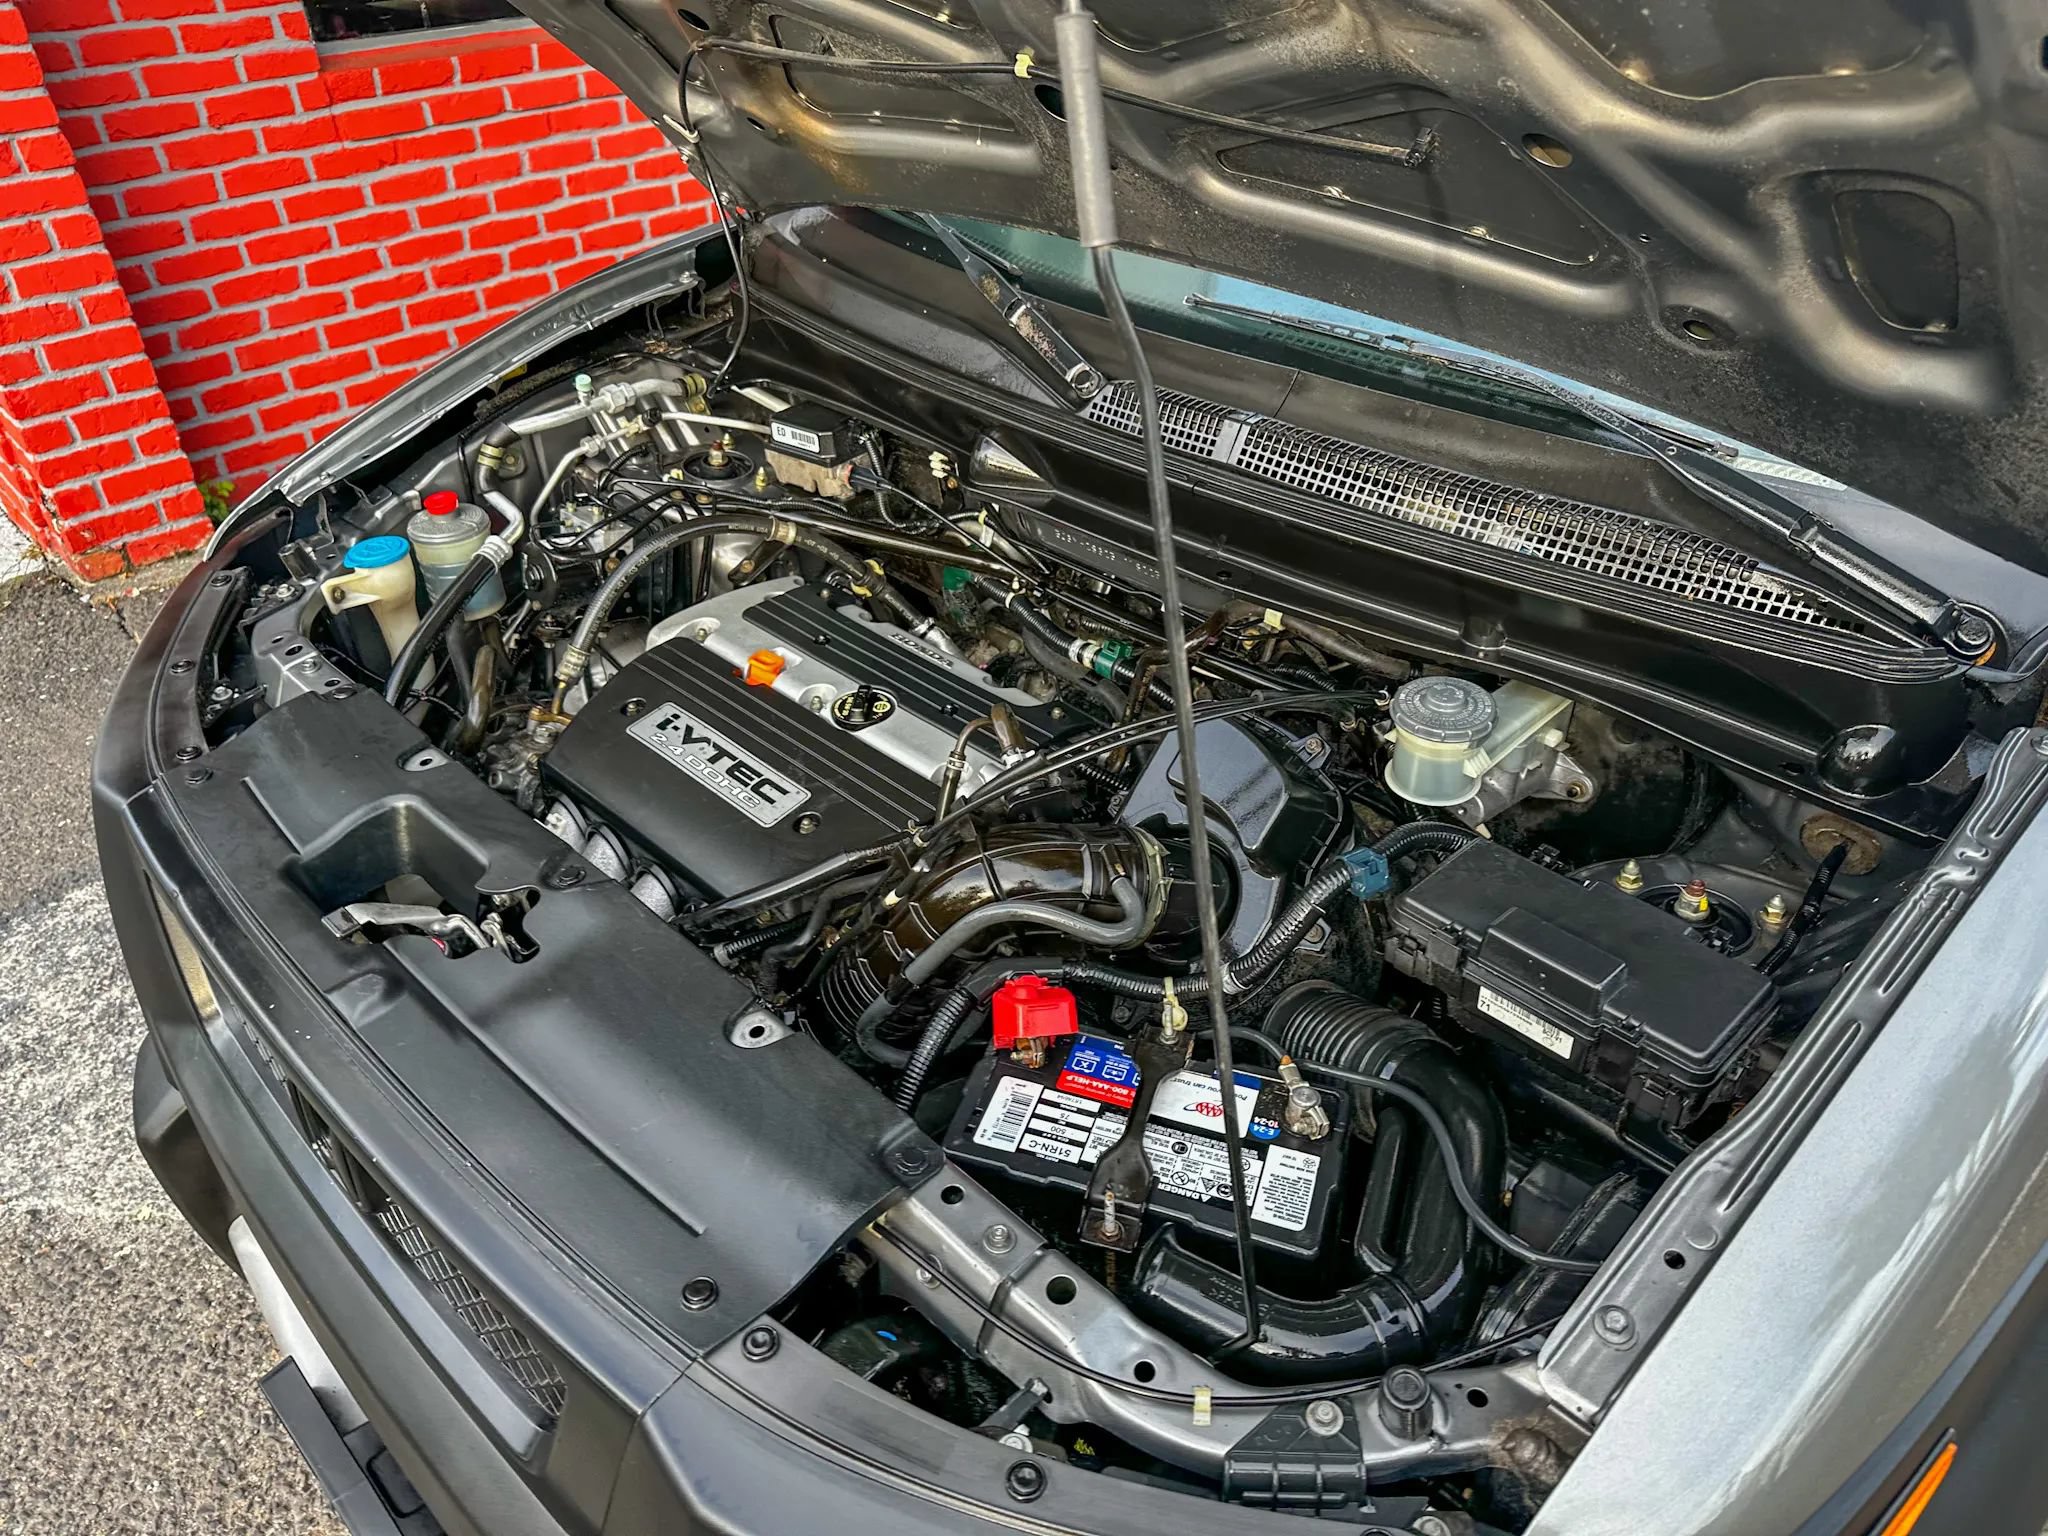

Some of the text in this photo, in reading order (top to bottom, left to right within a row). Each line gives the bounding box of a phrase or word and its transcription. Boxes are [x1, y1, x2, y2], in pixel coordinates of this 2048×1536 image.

[656, 713, 791, 805] i-VTEC
[650, 733, 761, 809] 2.4 DOHC
[1065, 1074, 1129, 1095] 800-AAA-HELP
[1174, 1077, 1191, 1086] trust
[1193, 1081, 1206, 1089] can
[1059, 1112, 1069, 1120] 75
[1197, 1102, 1222, 1117] AAA
[1254, 1116, 1279, 1128] 10-24
[1050, 1125, 1066, 1135] 500
[1254, 1124, 1275, 1136] E-24
[1029, 1139, 1072, 1157] 51RN-C
[1157, 1182, 1200, 1199] DANGER
